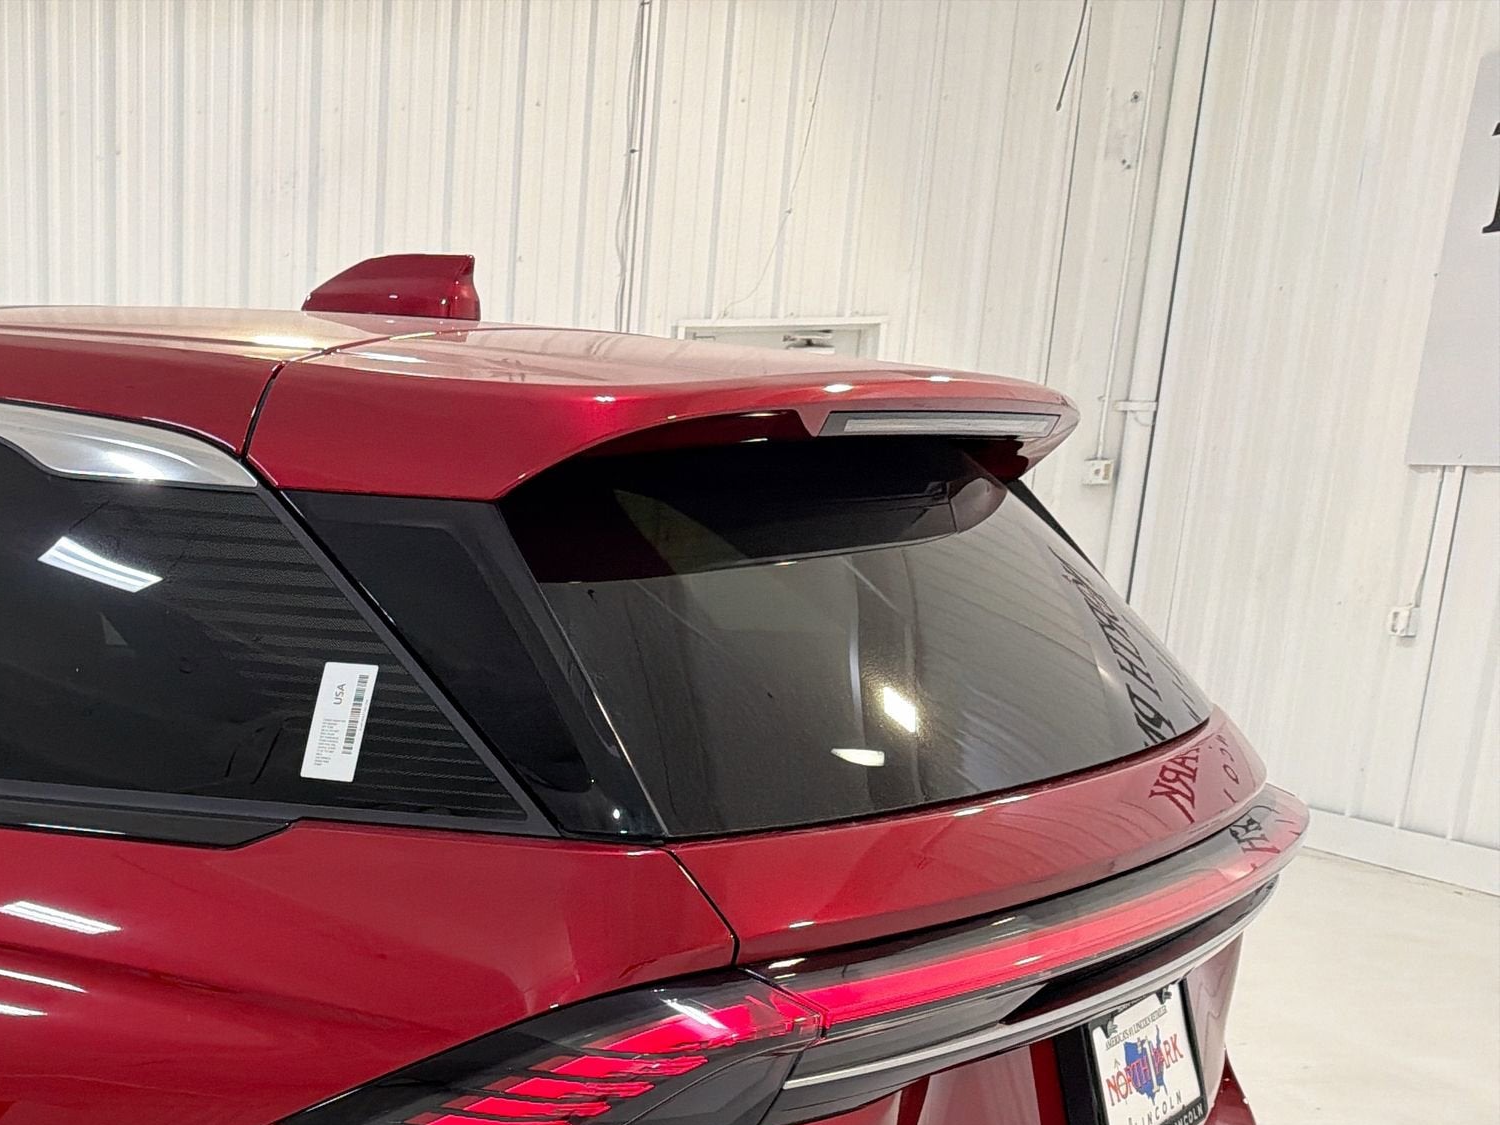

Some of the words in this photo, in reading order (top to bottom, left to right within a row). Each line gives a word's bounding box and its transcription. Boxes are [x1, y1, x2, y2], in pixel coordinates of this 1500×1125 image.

[333, 683, 347, 705] USA
[1105, 1055, 1153, 1107] NORTH
[1151, 1033, 1184, 1076] PARK
